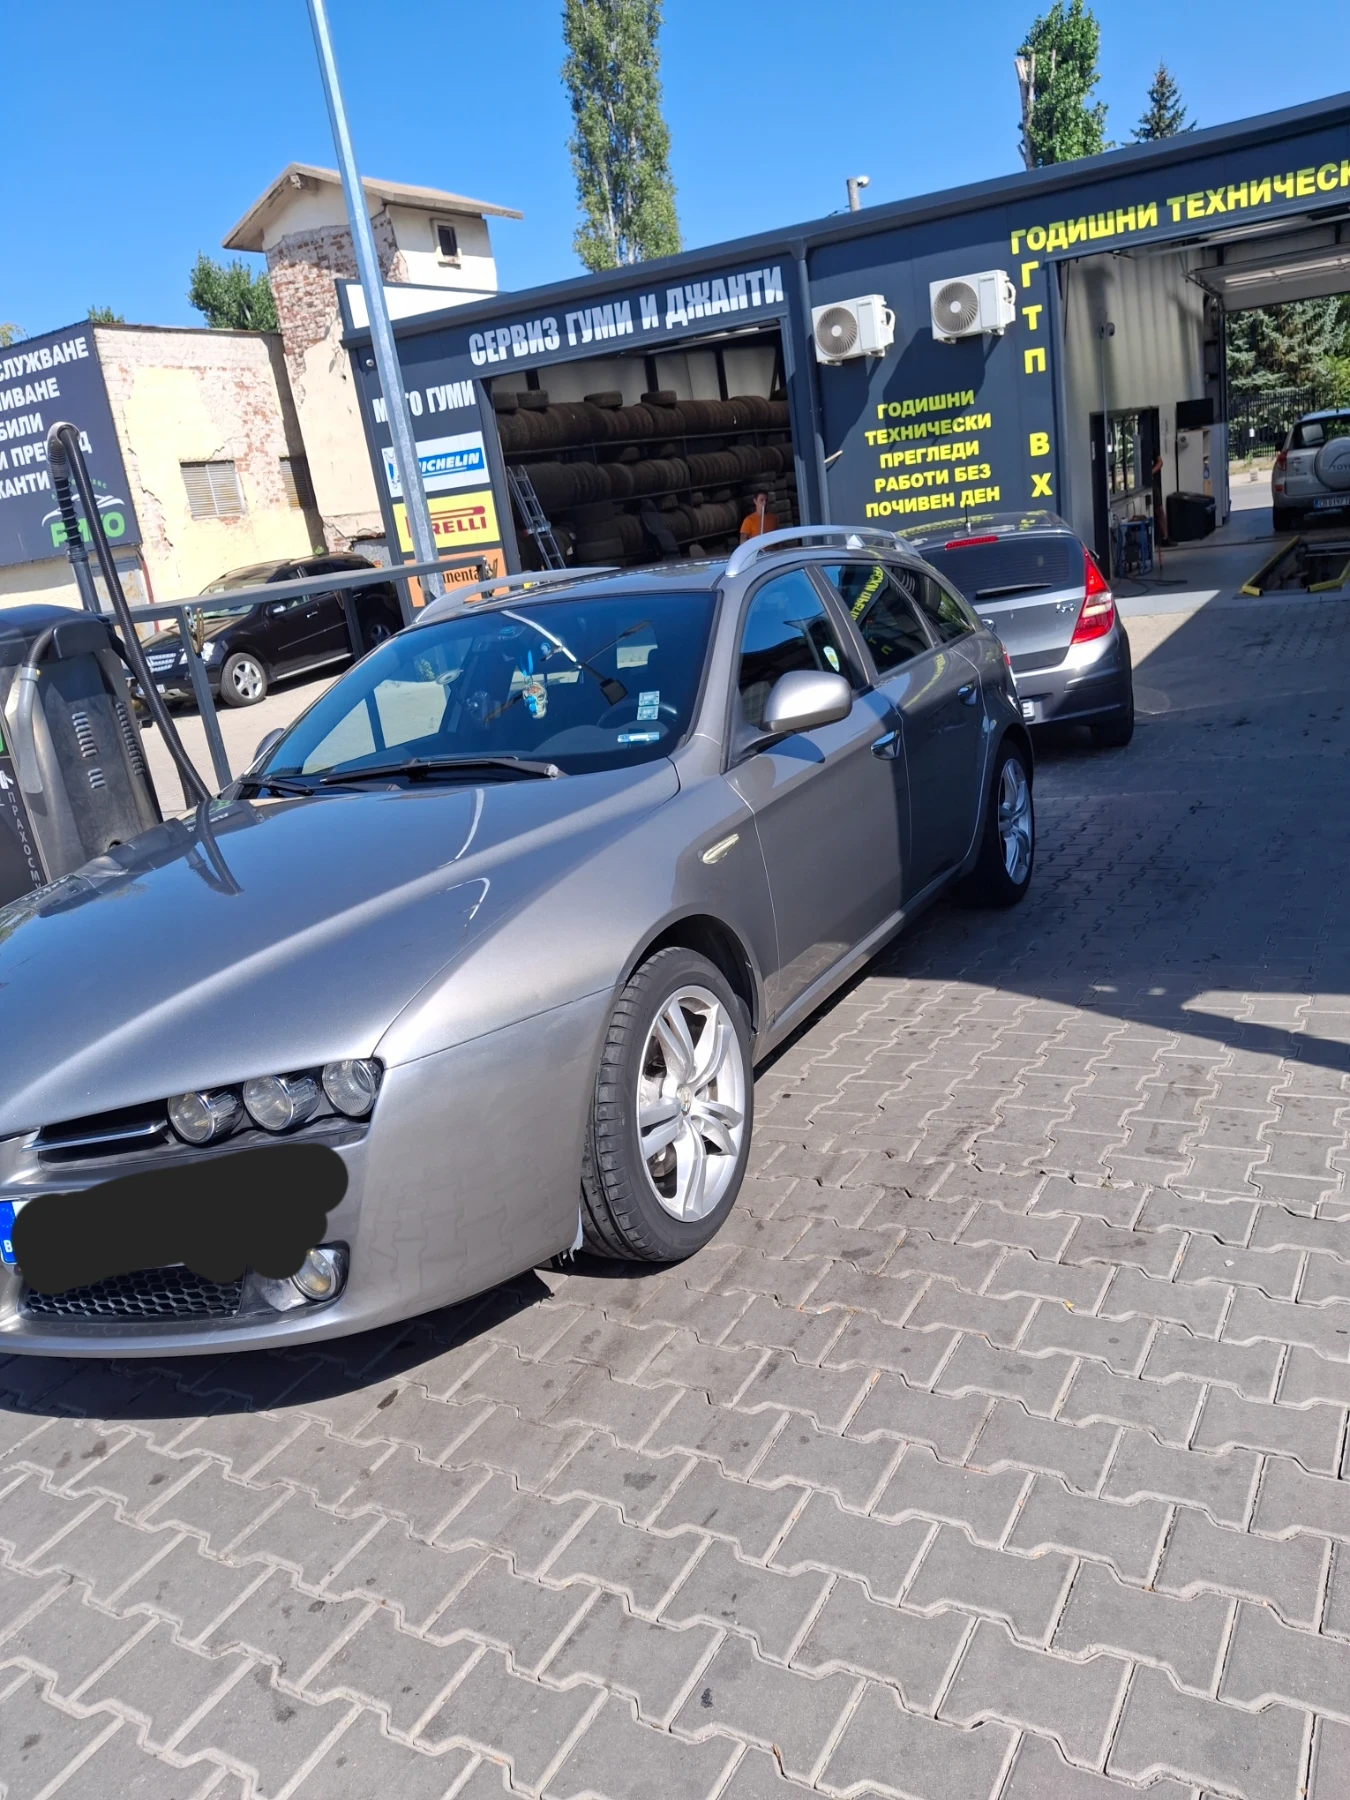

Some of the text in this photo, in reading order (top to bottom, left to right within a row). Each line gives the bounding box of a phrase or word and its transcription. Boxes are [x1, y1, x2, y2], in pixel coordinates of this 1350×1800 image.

[1011, 202, 1158, 255] ГОДИШНИ
[469, 266, 784, 366] СЕРВИЗ ГУМИ И ДЖАНТИ
[0, 377, 60, 412] ИВАНЕ
[372, 380, 476, 423] МО ГУМИ
[877, 390, 974, 419] ГОДИШНИ
[864, 413, 992, 446] ТЕХНИЧЕСКИ
[418, 452, 480, 473] ICHELIN
[880, 440, 979, 469] ПРЕГЛЕДИ
[1333, 463, 1350, 471] TOY
[874, 463, 991, 493] РАБОТИ БЕЗ
[865, 486, 1001, 518] ПОЧИВЕН ДЕН
[405, 516, 487, 538] RELLI
